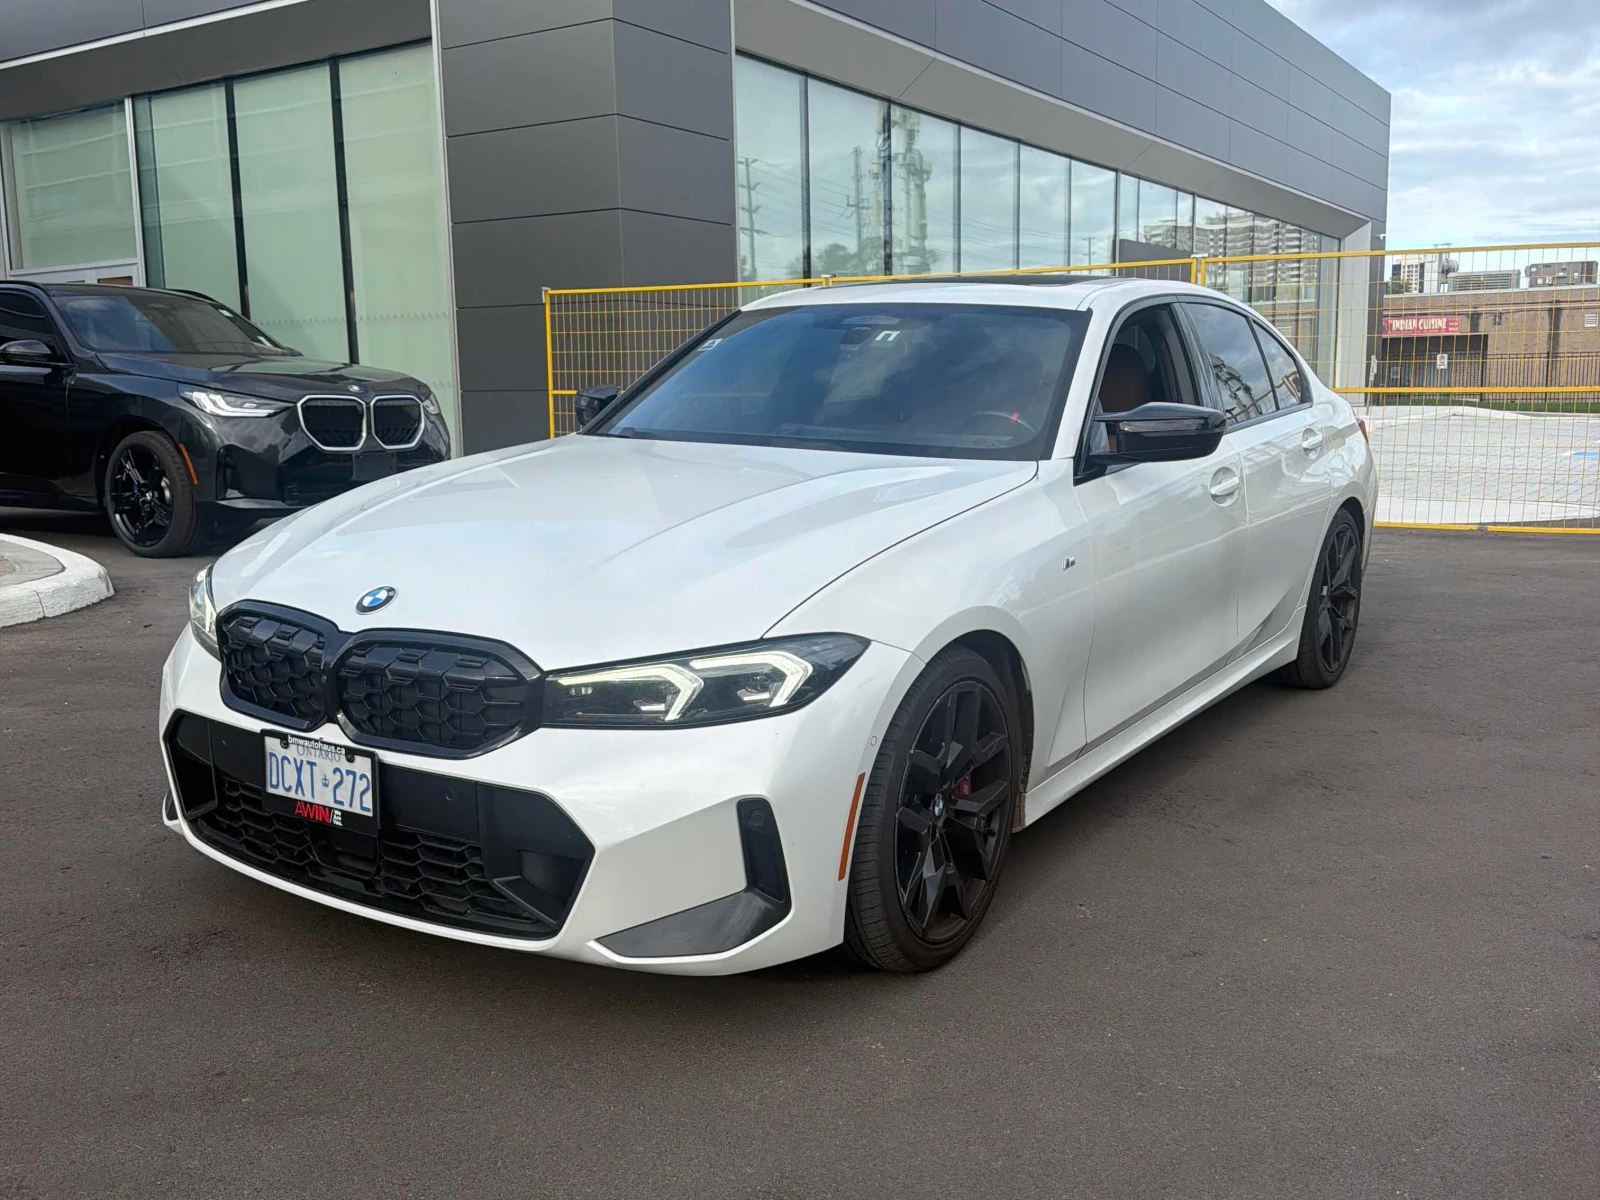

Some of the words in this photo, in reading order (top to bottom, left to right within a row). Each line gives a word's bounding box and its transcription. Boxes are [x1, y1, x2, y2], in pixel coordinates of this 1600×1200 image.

[1392, 319, 1417, 331] INDIAN
[1418, 317, 1447, 330] CUISINE
[288, 734, 346, 755] bmwautohaus.ca
[268, 752, 317, 799] DCXT
[332, 767, 371, 813] 272
[294, 800, 330, 824] AWIN
